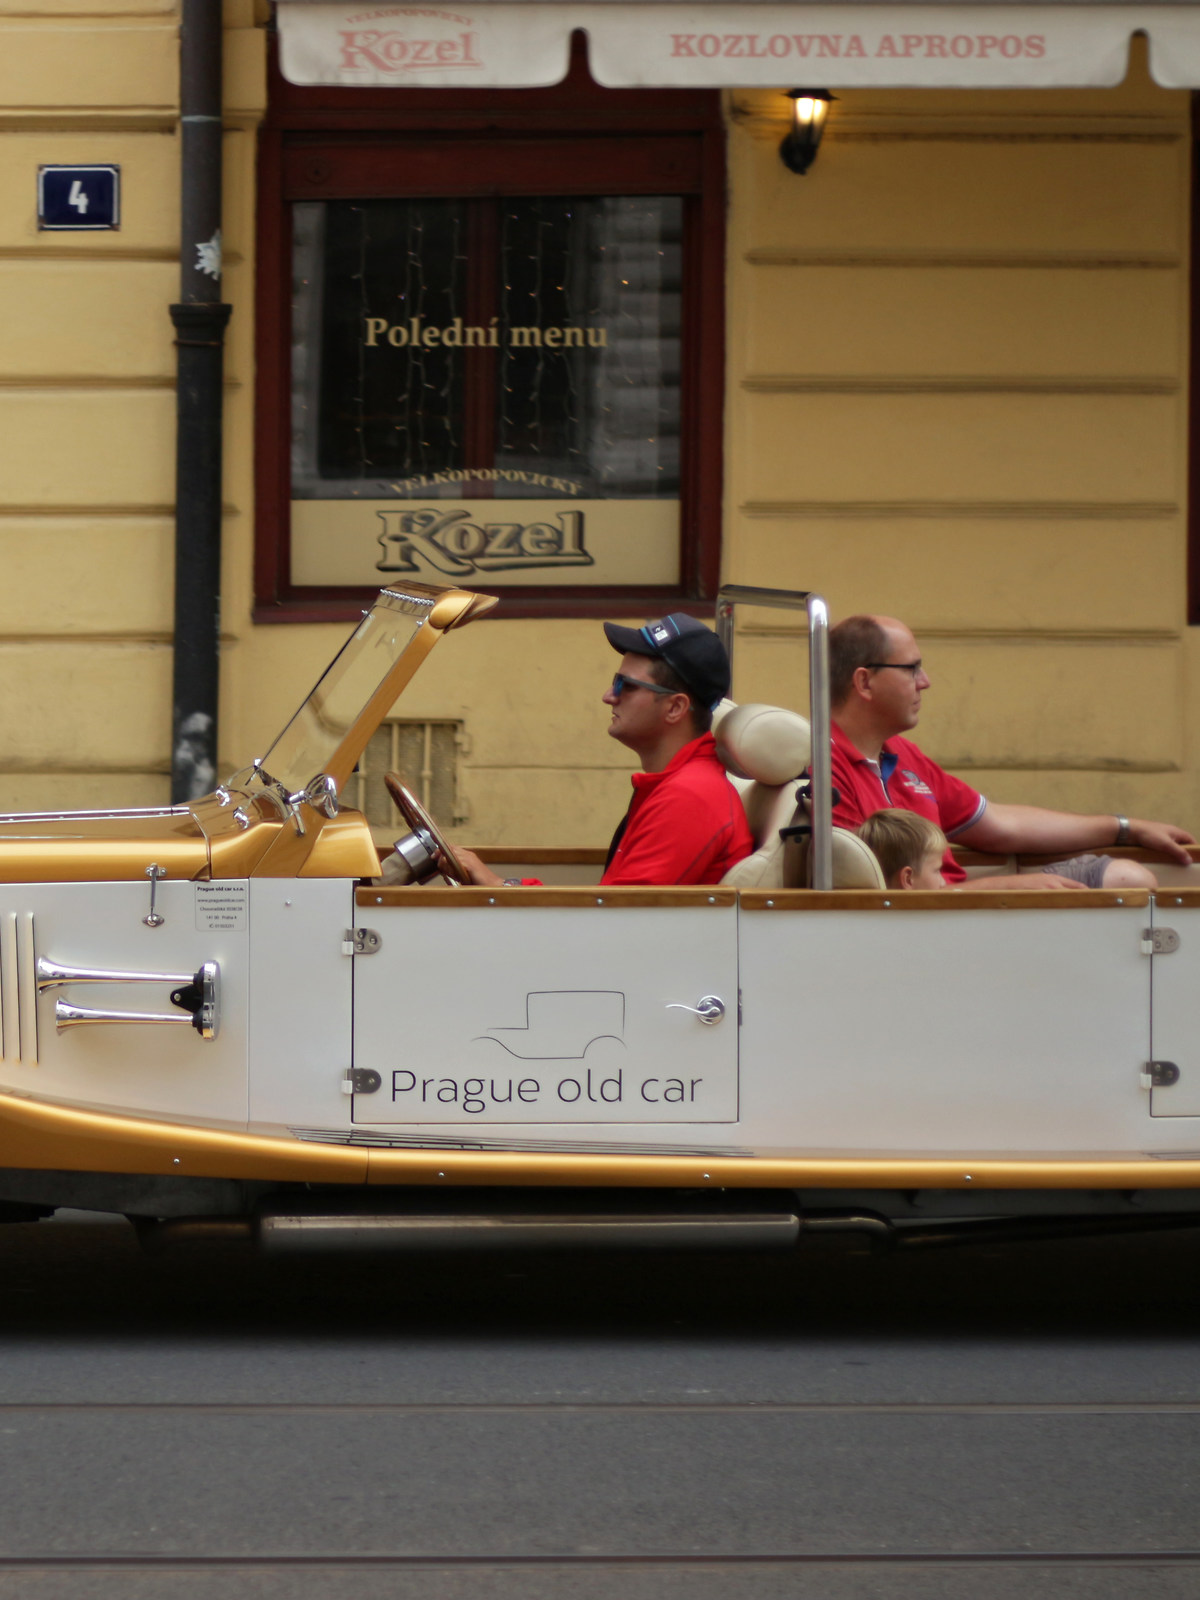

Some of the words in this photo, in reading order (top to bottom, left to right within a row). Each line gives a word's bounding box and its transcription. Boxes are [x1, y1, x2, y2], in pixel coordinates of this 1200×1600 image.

[337, 29, 484, 76] Kozel
[670, 34, 868, 59] KOZLOVNA
[876, 34, 1046, 59] APROPOS
[68, 180, 89, 214] 4
[363, 317, 500, 348] Polední
[509, 326, 608, 348] menu
[375, 508, 595, 577] Kozel
[391, 1069, 540, 1114] Prague
[557, 1068, 623, 1103] old
[640, 1077, 703, 1103] car
